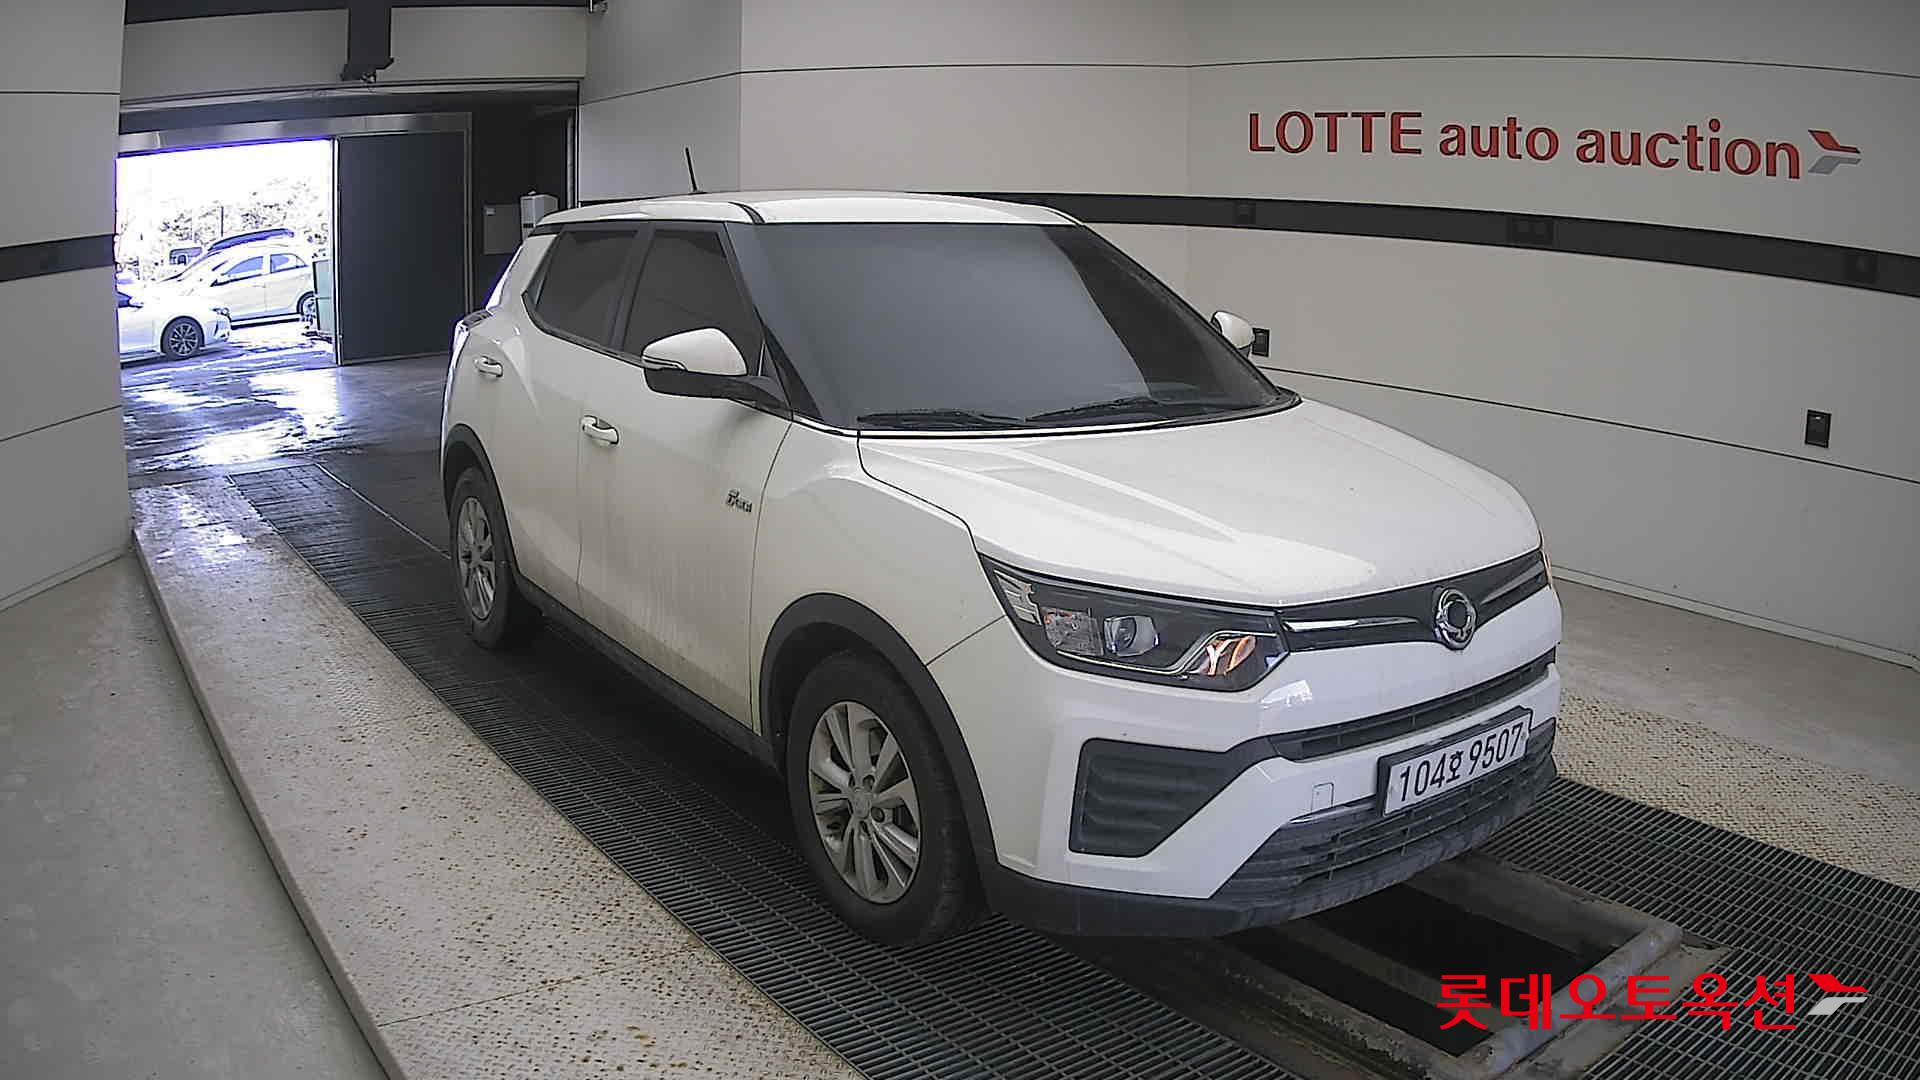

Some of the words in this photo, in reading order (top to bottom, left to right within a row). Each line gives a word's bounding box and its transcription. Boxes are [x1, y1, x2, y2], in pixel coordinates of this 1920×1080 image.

[1248, 111, 1423, 154] LOTTE
[1439, 116, 1559, 161] auto
[1575, 118, 1801, 180] auction
[1469, 722, 1524, 775] 9507
